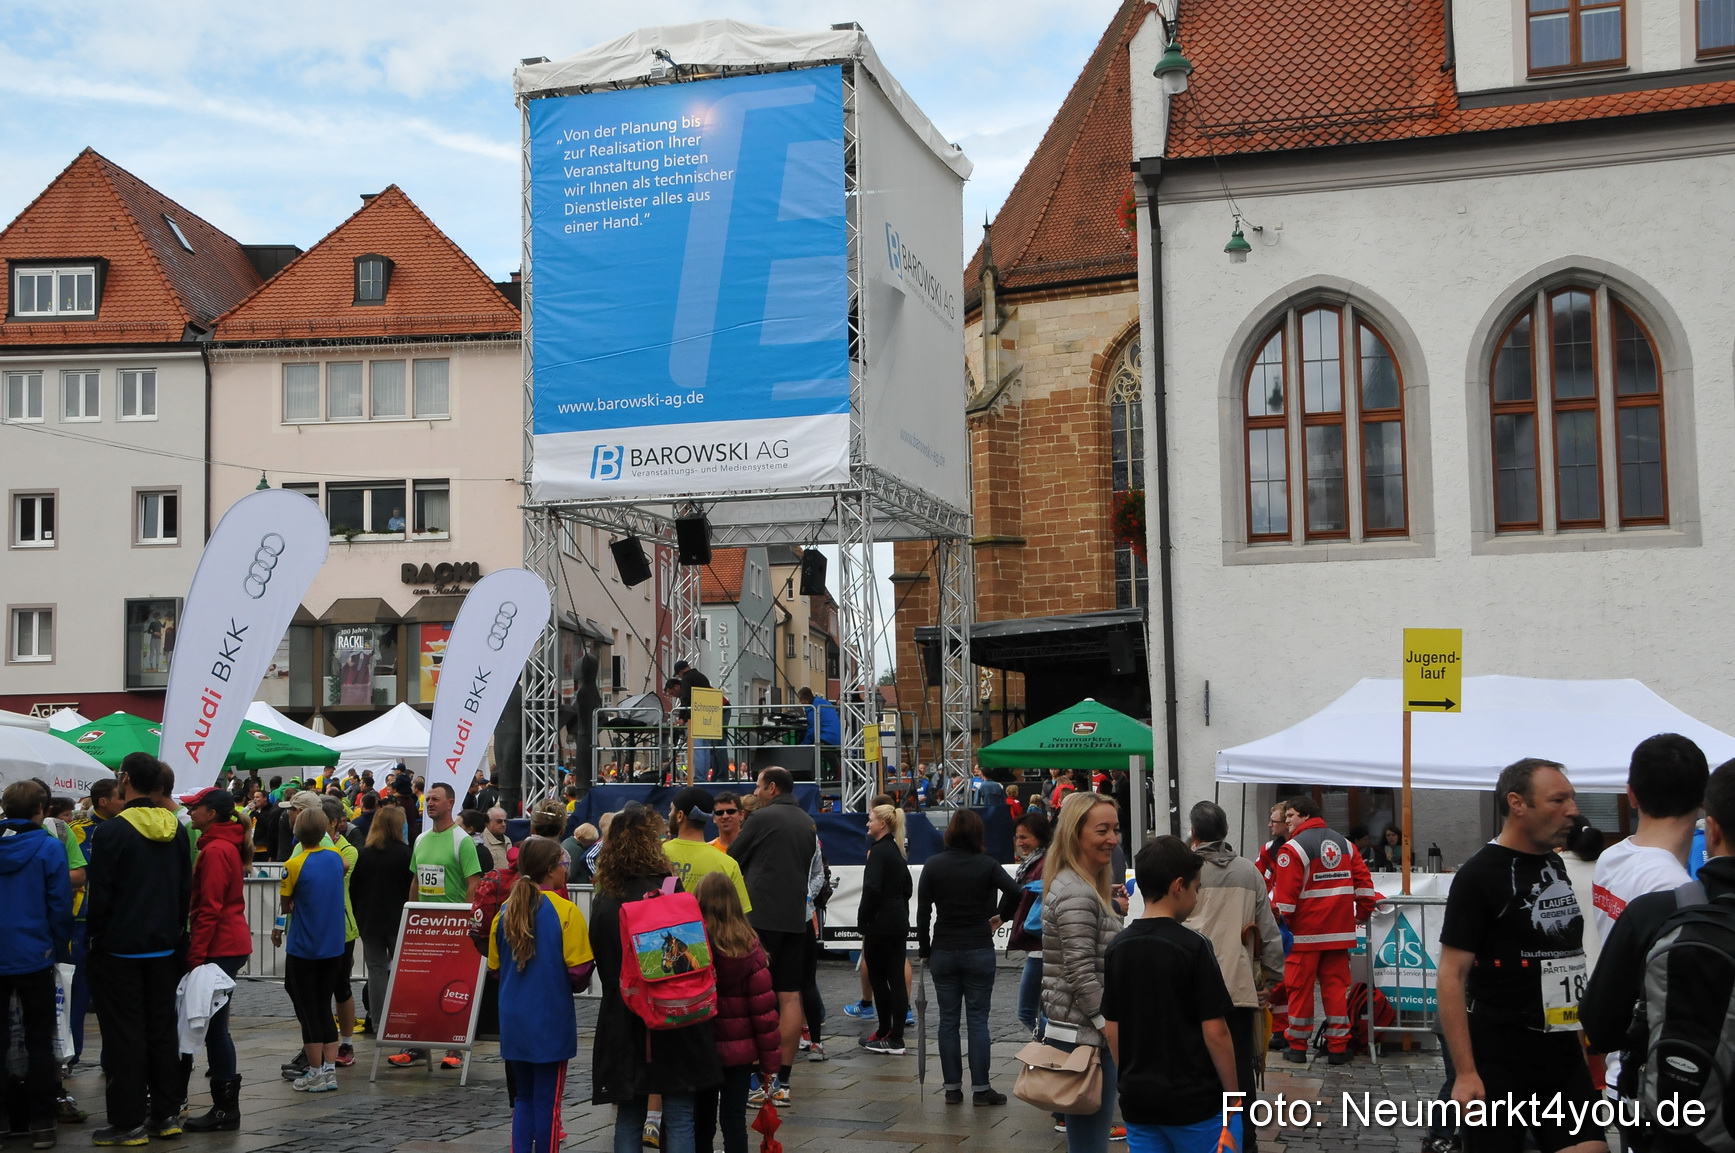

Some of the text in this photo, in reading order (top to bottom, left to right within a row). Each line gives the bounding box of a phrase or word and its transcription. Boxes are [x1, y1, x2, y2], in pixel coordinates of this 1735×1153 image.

[594, 124, 617, 138] der
[621, 120, 677, 136] Planung
[682, 115, 702, 128] bis
[564, 135, 702, 160] zur Realisation Ihrer
[564, 153, 708, 178] Veranstaltung bieten
[564, 168, 734, 197] wir Ihnen als technischer
[564, 190, 710, 216] Dienstleister alles aus
[564, 218, 599, 234] einer
[902, 244, 955, 320] BAROWSKI AG
[558, 390, 704, 414] www.barowski-ag.de
[630, 439, 790, 467] BAROWSKI AG
[632, 462, 788, 478] Veranstaltungs- und Mediensysteme
[401, 562, 484, 584] RACKL
[352, 627, 368, 635] Jahre
[338, 636, 364, 648] RACKL
[1406, 650, 1460, 666] Jugend-
[1420, 666, 1446, 680] lauf
[185, 617, 250, 764] Audi BKK
[446, 665, 492, 775] Audi BKK
[54, 777, 92, 791] Audi BK
[420, 872, 438, 886] 195
[408, 914, 468, 927] Gewinn
[1540, 910, 1566, 918] GEGEN
[444, 988, 469, 1000] Jetzt
